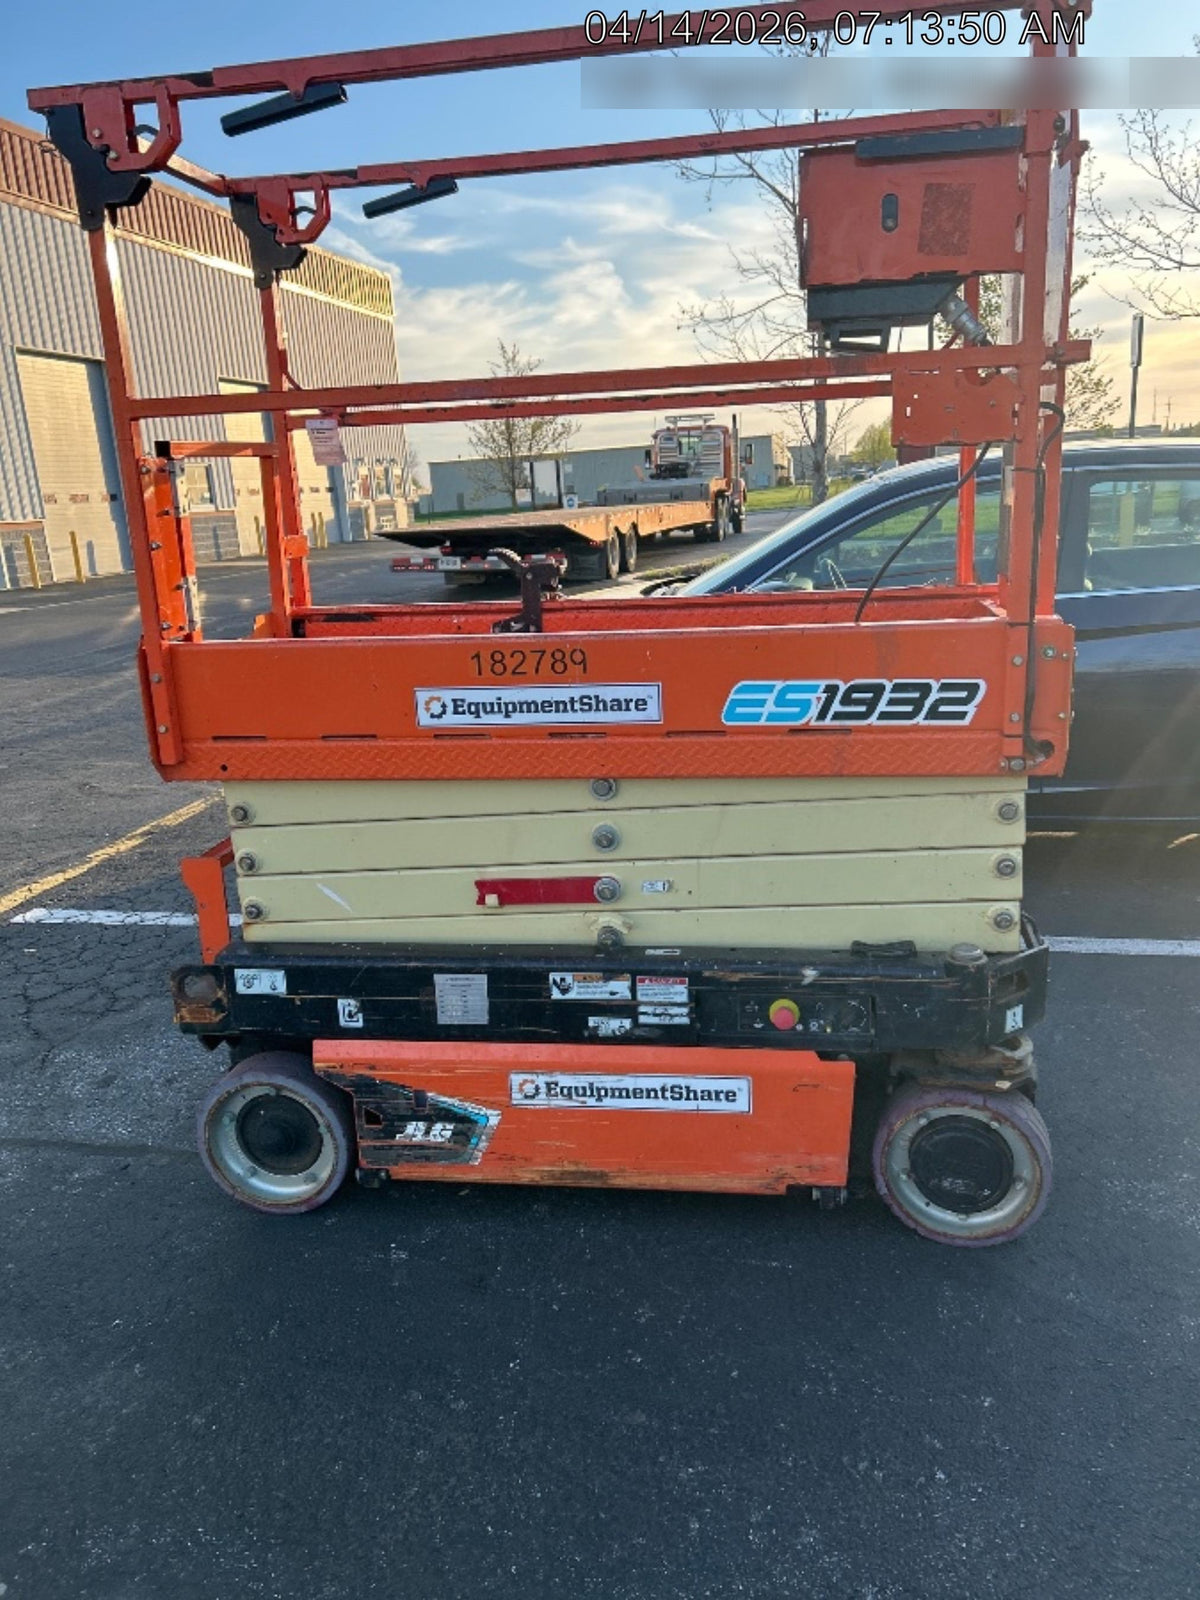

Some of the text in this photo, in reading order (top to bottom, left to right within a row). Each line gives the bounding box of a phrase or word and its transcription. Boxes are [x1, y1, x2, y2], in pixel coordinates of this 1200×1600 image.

[470, 648, 588, 677] 182789
[451, 694, 648, 719] EquipmentShare
[722, 680, 985, 725] ES1932
[544, 1080, 738, 1103] EquipmentShare
